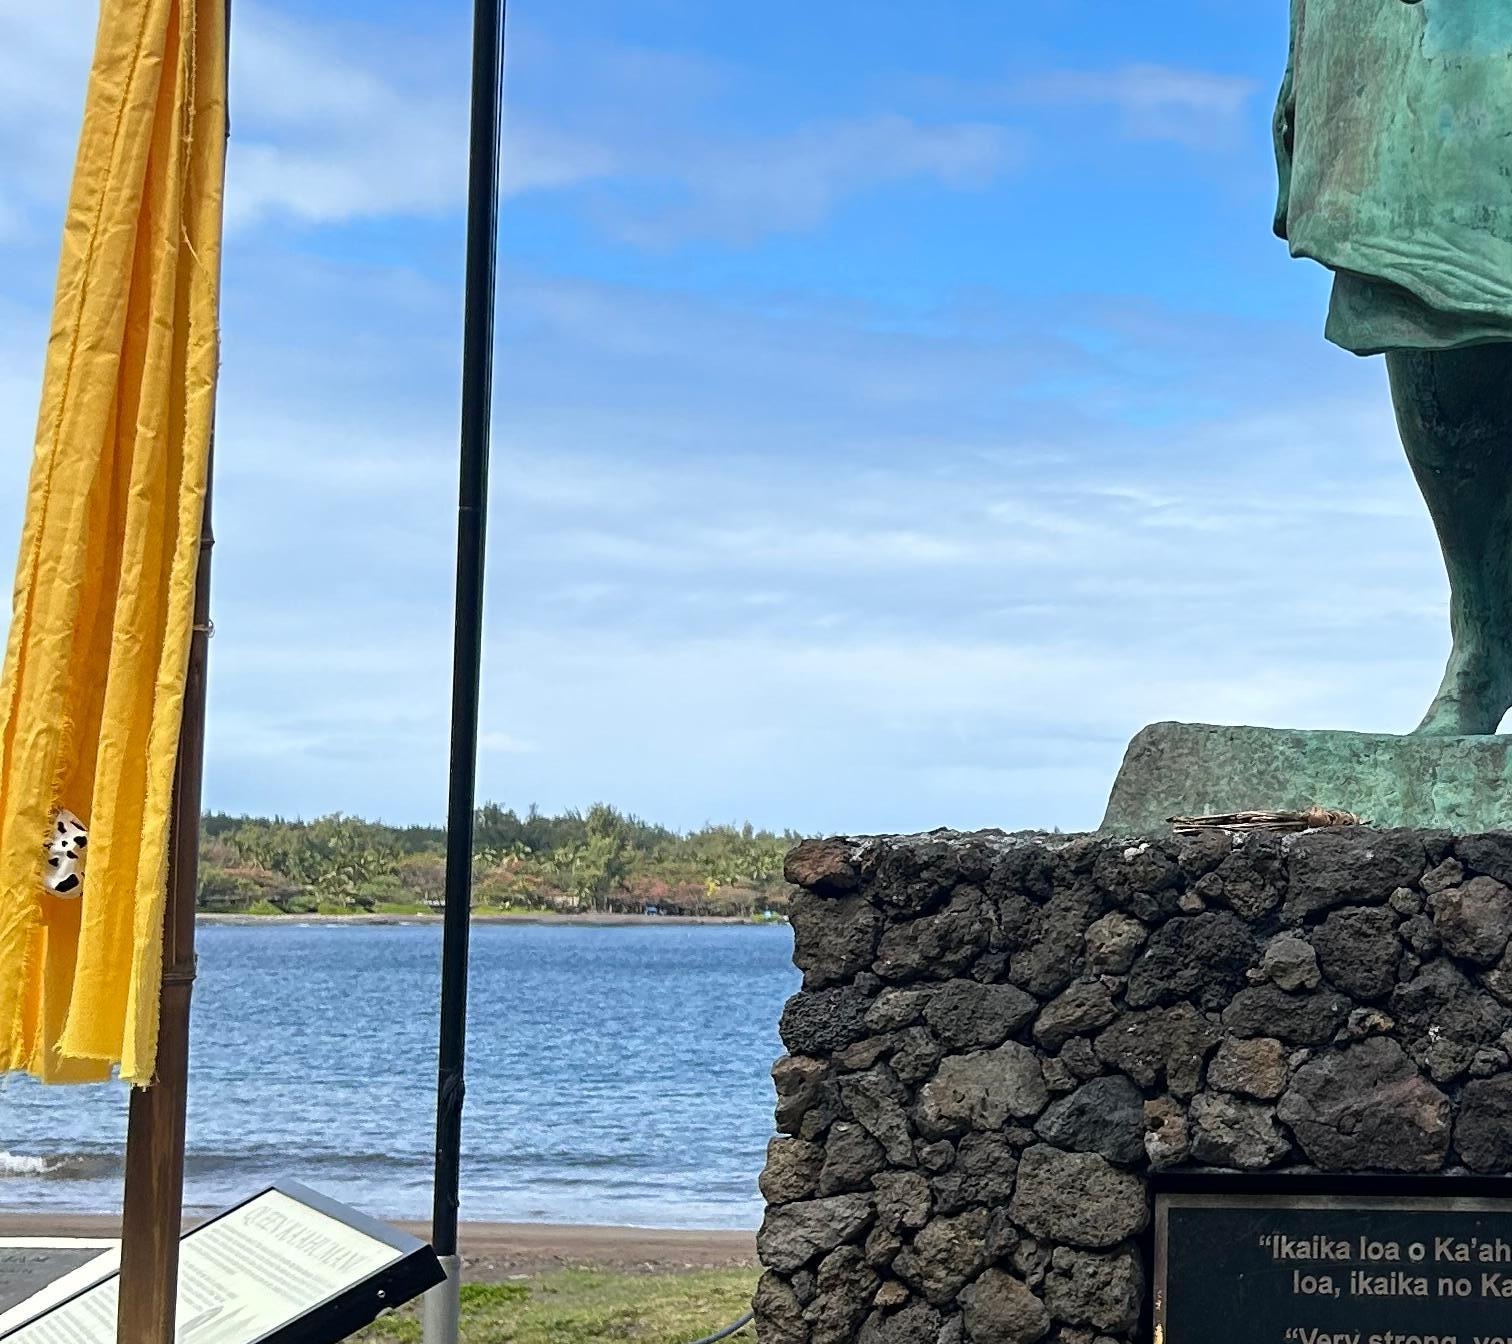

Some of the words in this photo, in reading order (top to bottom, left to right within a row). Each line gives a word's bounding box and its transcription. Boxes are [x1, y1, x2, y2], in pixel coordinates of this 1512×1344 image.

[1360, 1235, 1401, 1261] loa
[1408, 1242, 1426, 1261] o
[1293, 1269, 1341, 1298] loa,
[1350, 1270, 1429, 1296] ikaika
[1438, 1278, 1472, 1297] no
